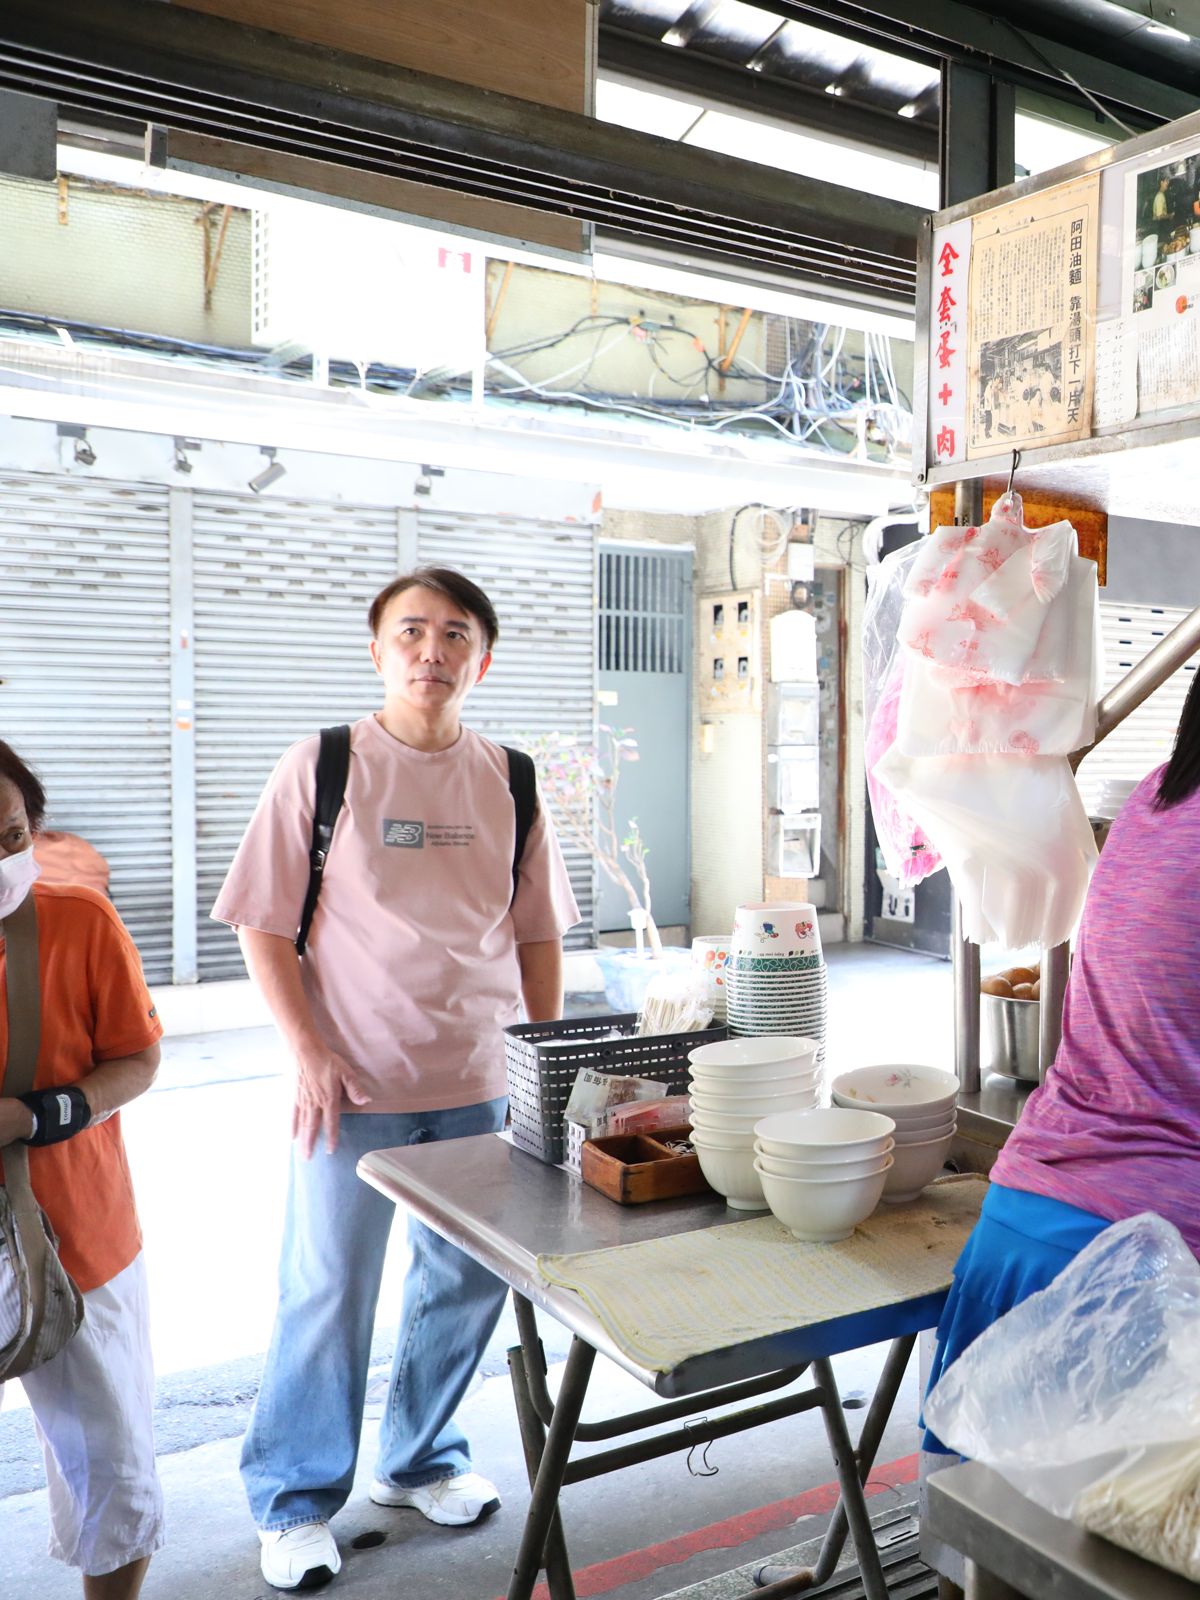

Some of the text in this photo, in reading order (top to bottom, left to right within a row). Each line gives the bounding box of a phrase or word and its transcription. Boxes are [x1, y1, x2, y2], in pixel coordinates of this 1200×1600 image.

[1067, 218, 1084, 425] 阿田油麵 靠湯頭打下一片天
